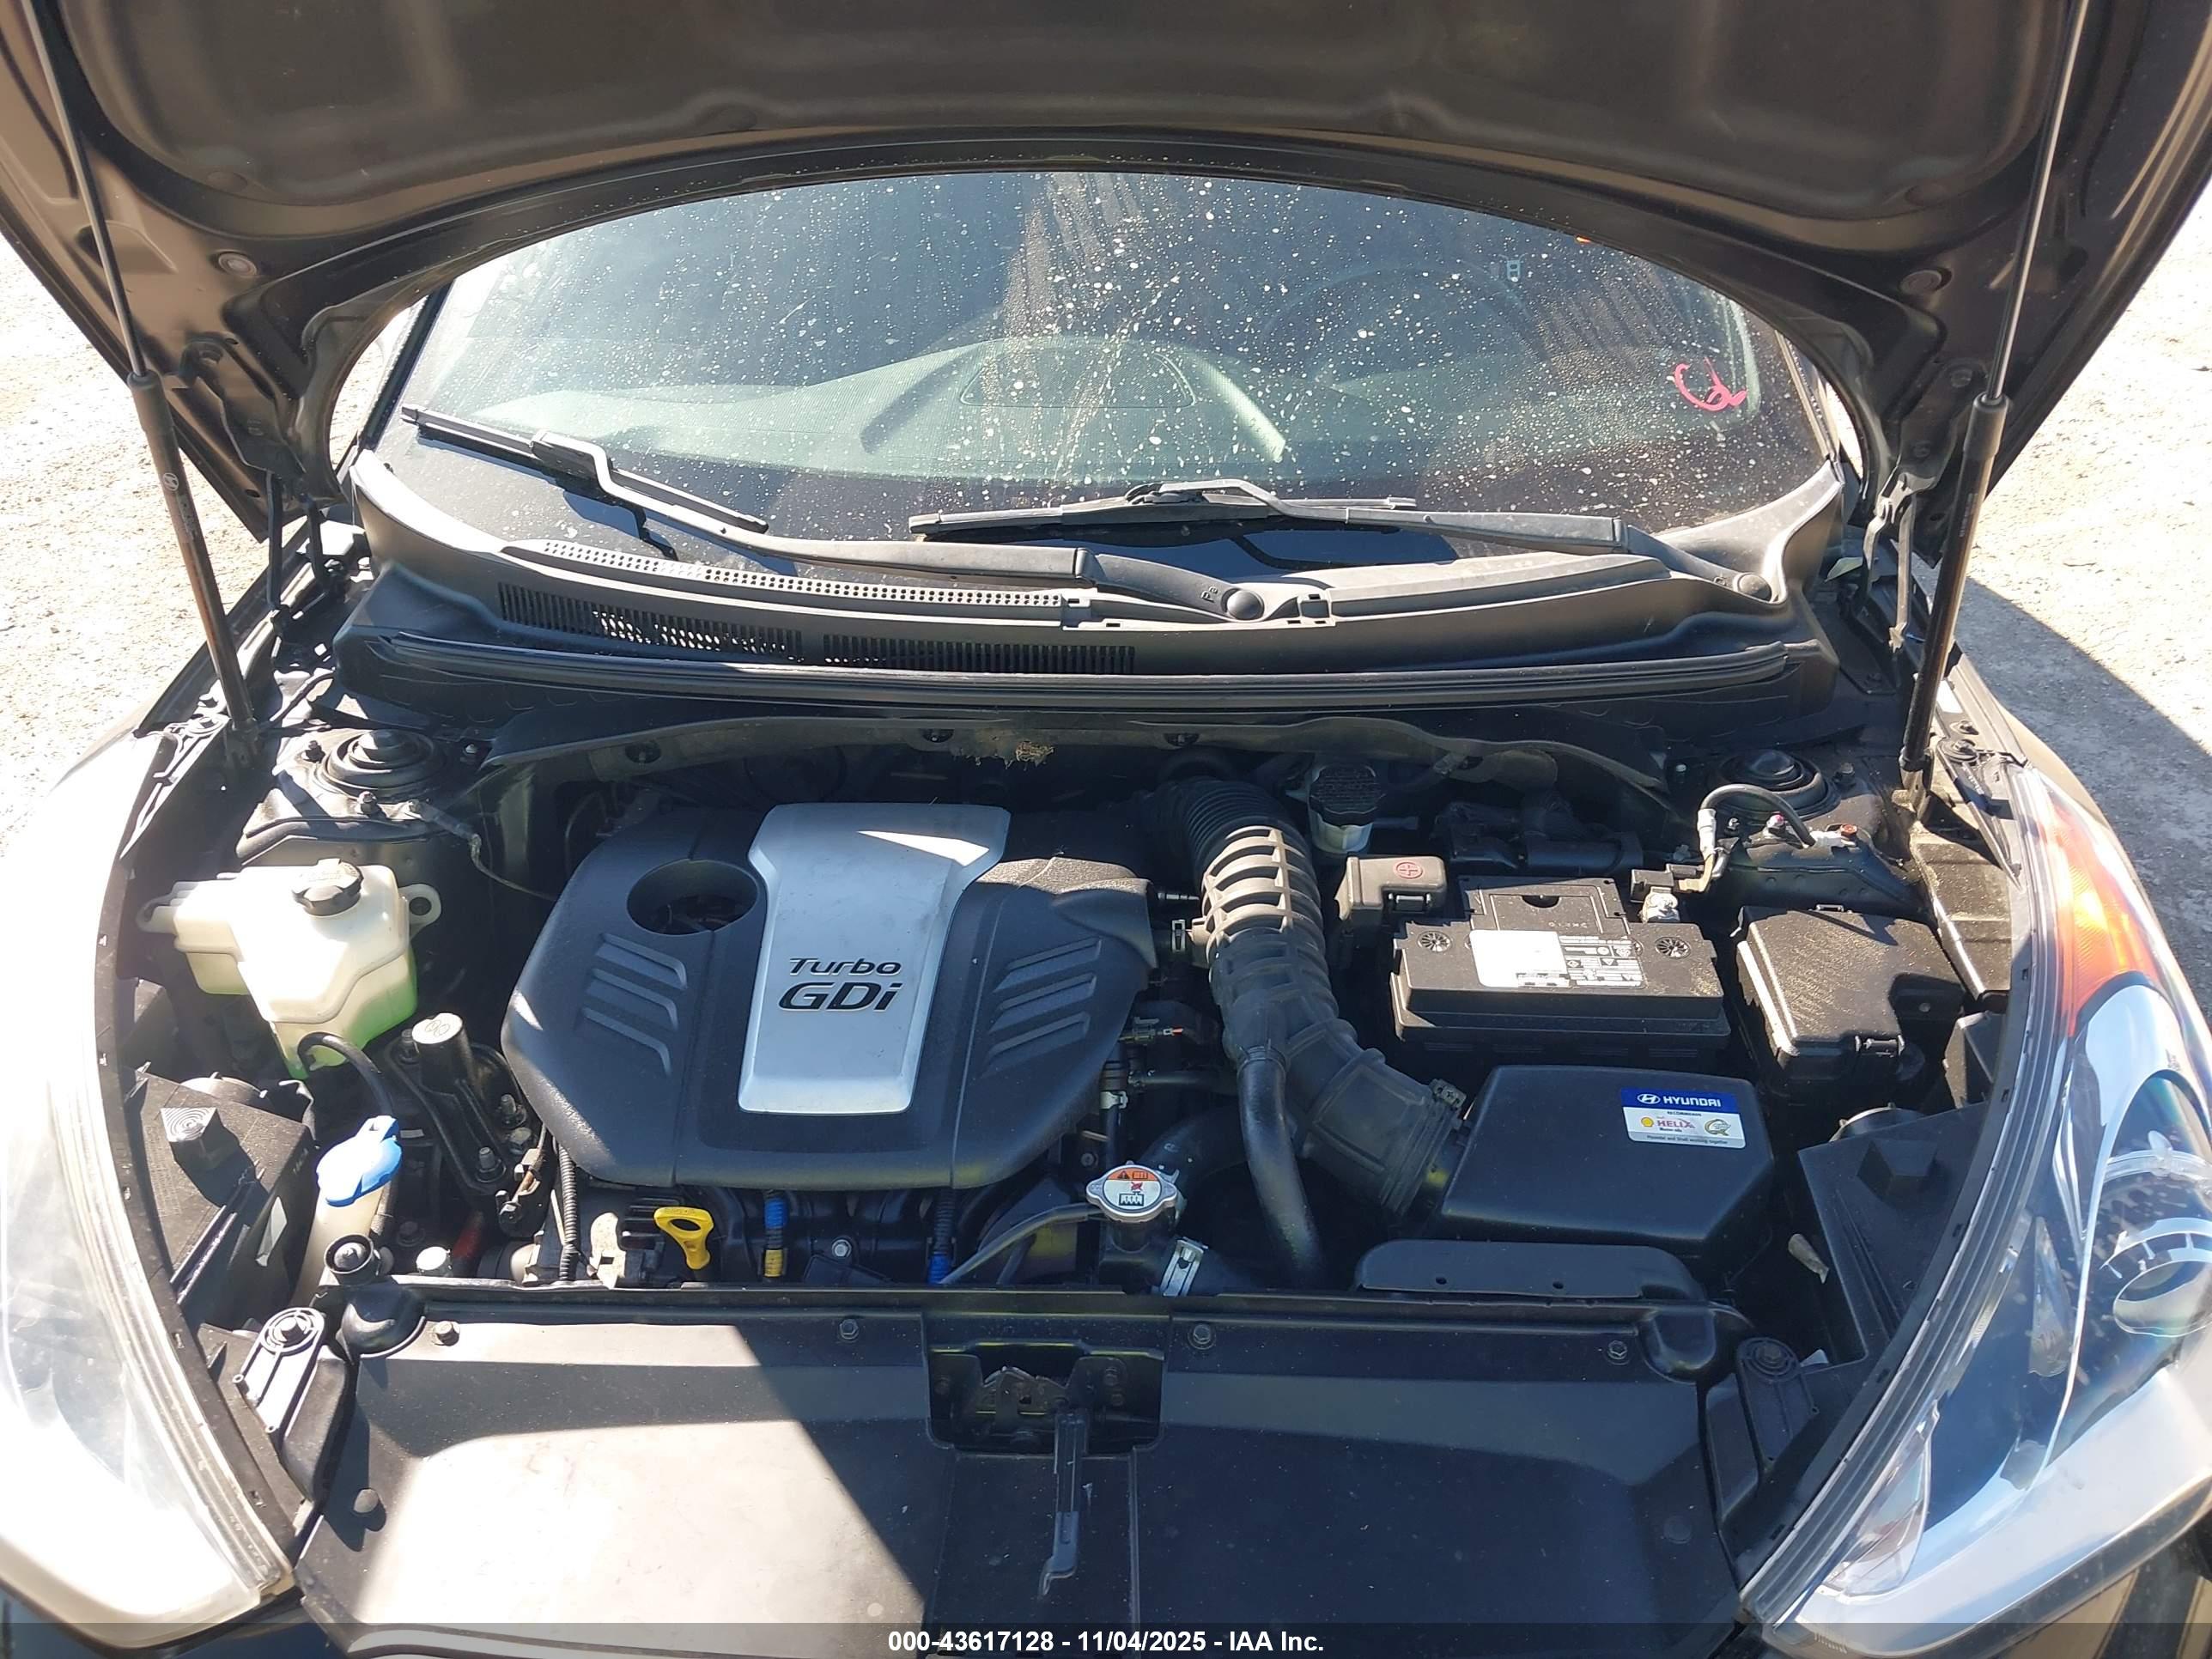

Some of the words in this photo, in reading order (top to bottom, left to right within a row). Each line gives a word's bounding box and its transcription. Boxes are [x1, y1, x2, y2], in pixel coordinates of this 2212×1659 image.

[789, 957, 902, 975] Turbo
[778, 981, 903, 1012] GDi
[1662, 1096, 1722, 1107] HYUNDAI
[1656, 1118, 1692, 1128] HELIX
